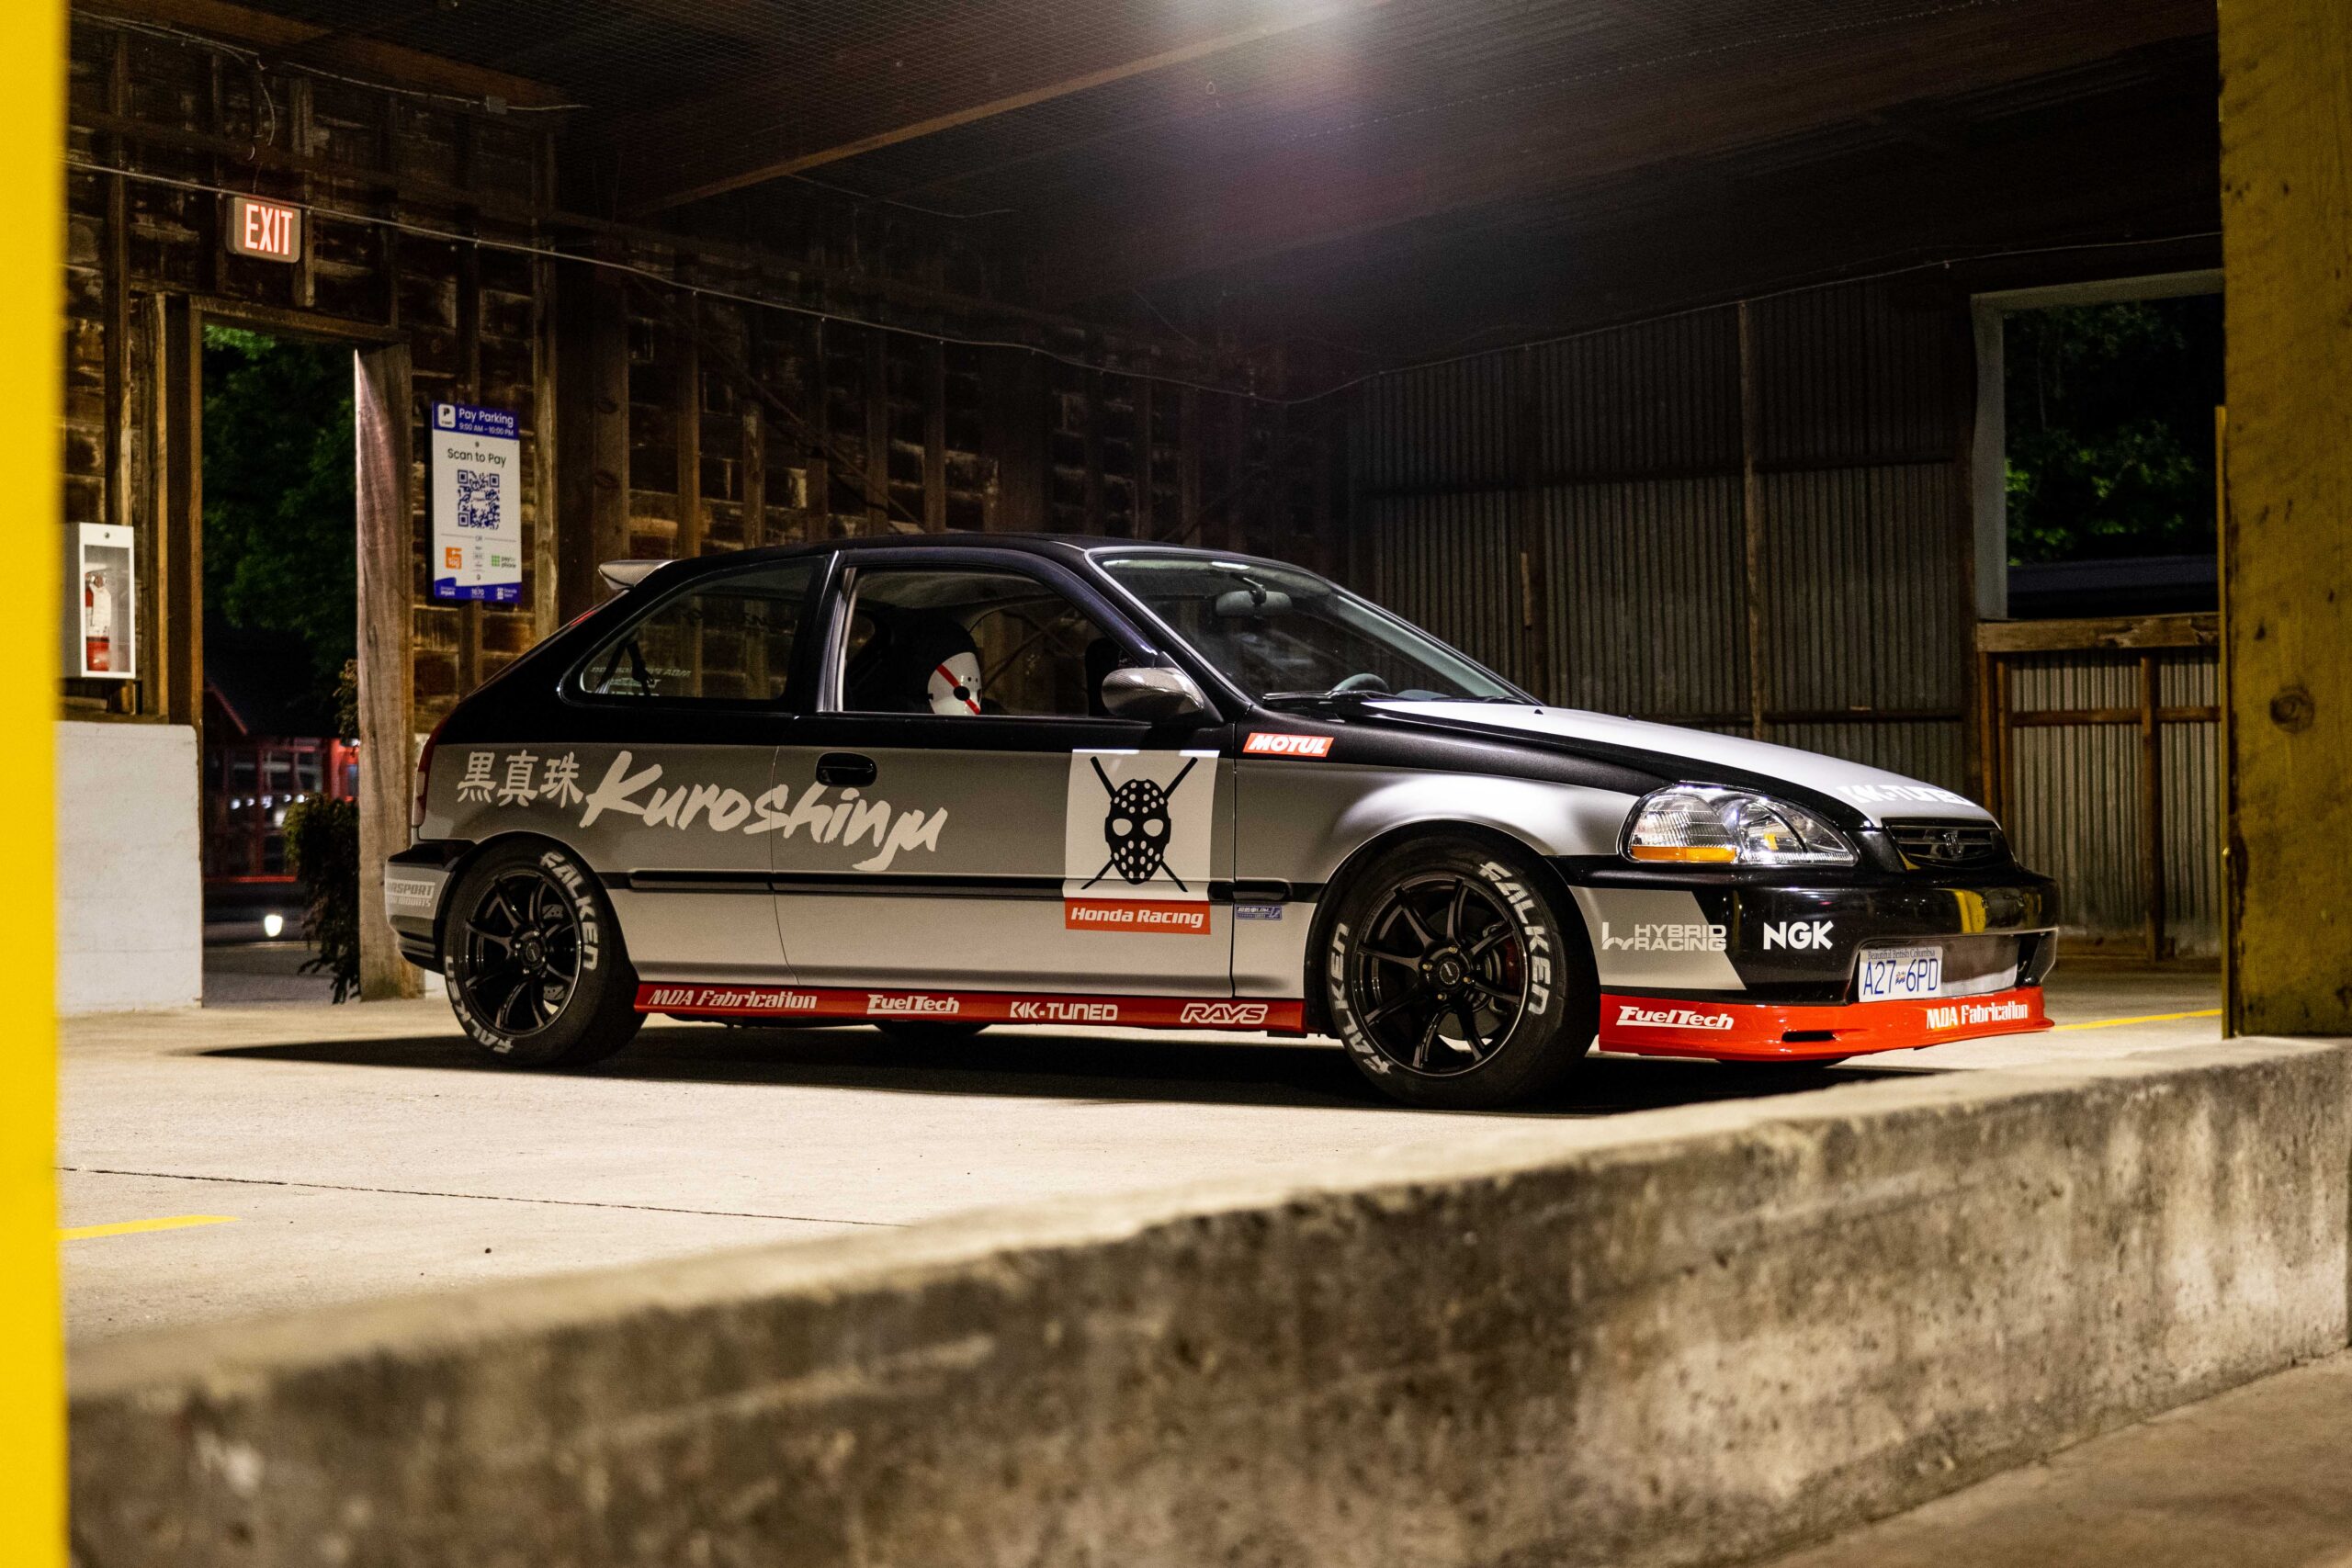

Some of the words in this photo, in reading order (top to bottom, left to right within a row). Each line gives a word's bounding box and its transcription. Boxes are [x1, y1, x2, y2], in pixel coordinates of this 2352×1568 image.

[244, 203, 293, 255] EXIT
[459, 408, 477, 423] Pay
[479, 411, 514, 428] Parking
[459, 423, 473, 431] 9:00
[489, 426, 503, 435] 10:00
[447, 448, 473, 461] Scan
[475, 453, 486, 463] to
[488, 453, 506, 468] Pay
[1248, 734, 1326, 754] MOTUL
[458, 750, 585, 808] 黒真珠
[580, 750, 947, 872] Kuroshinju
[540, 851, 599, 971] FALKEN
[1070, 908, 1135, 922] Honda
[1136, 909, 1204, 929] Racing
[1477, 862, 1551, 1015] FALKEN
[1634, 924, 1727, 938] HYBRID
[1763, 920, 1834, 950] NGK
[1634, 937, 1727, 952] RACING
[1868, 950, 1892, 960] Beautiful
[1893, 948, 1910, 959] British
[1910, 947, 1936, 957] Columbia
[1863, 959, 1896, 995] A27
[1906, 958, 1939, 992] 6PD
[648, 989, 692, 1005] MDA
[696, 990, 818, 1010] Fabrication
[866, 994, 960, 1014] FuelTech
[1330, 922, 1392, 1075] FALKEN
[1180, 1003, 1268, 1024] RAYS
[1616, 1006, 1735, 1030] FuelTech
[1961, 1000, 2028, 1025] Fabrication
